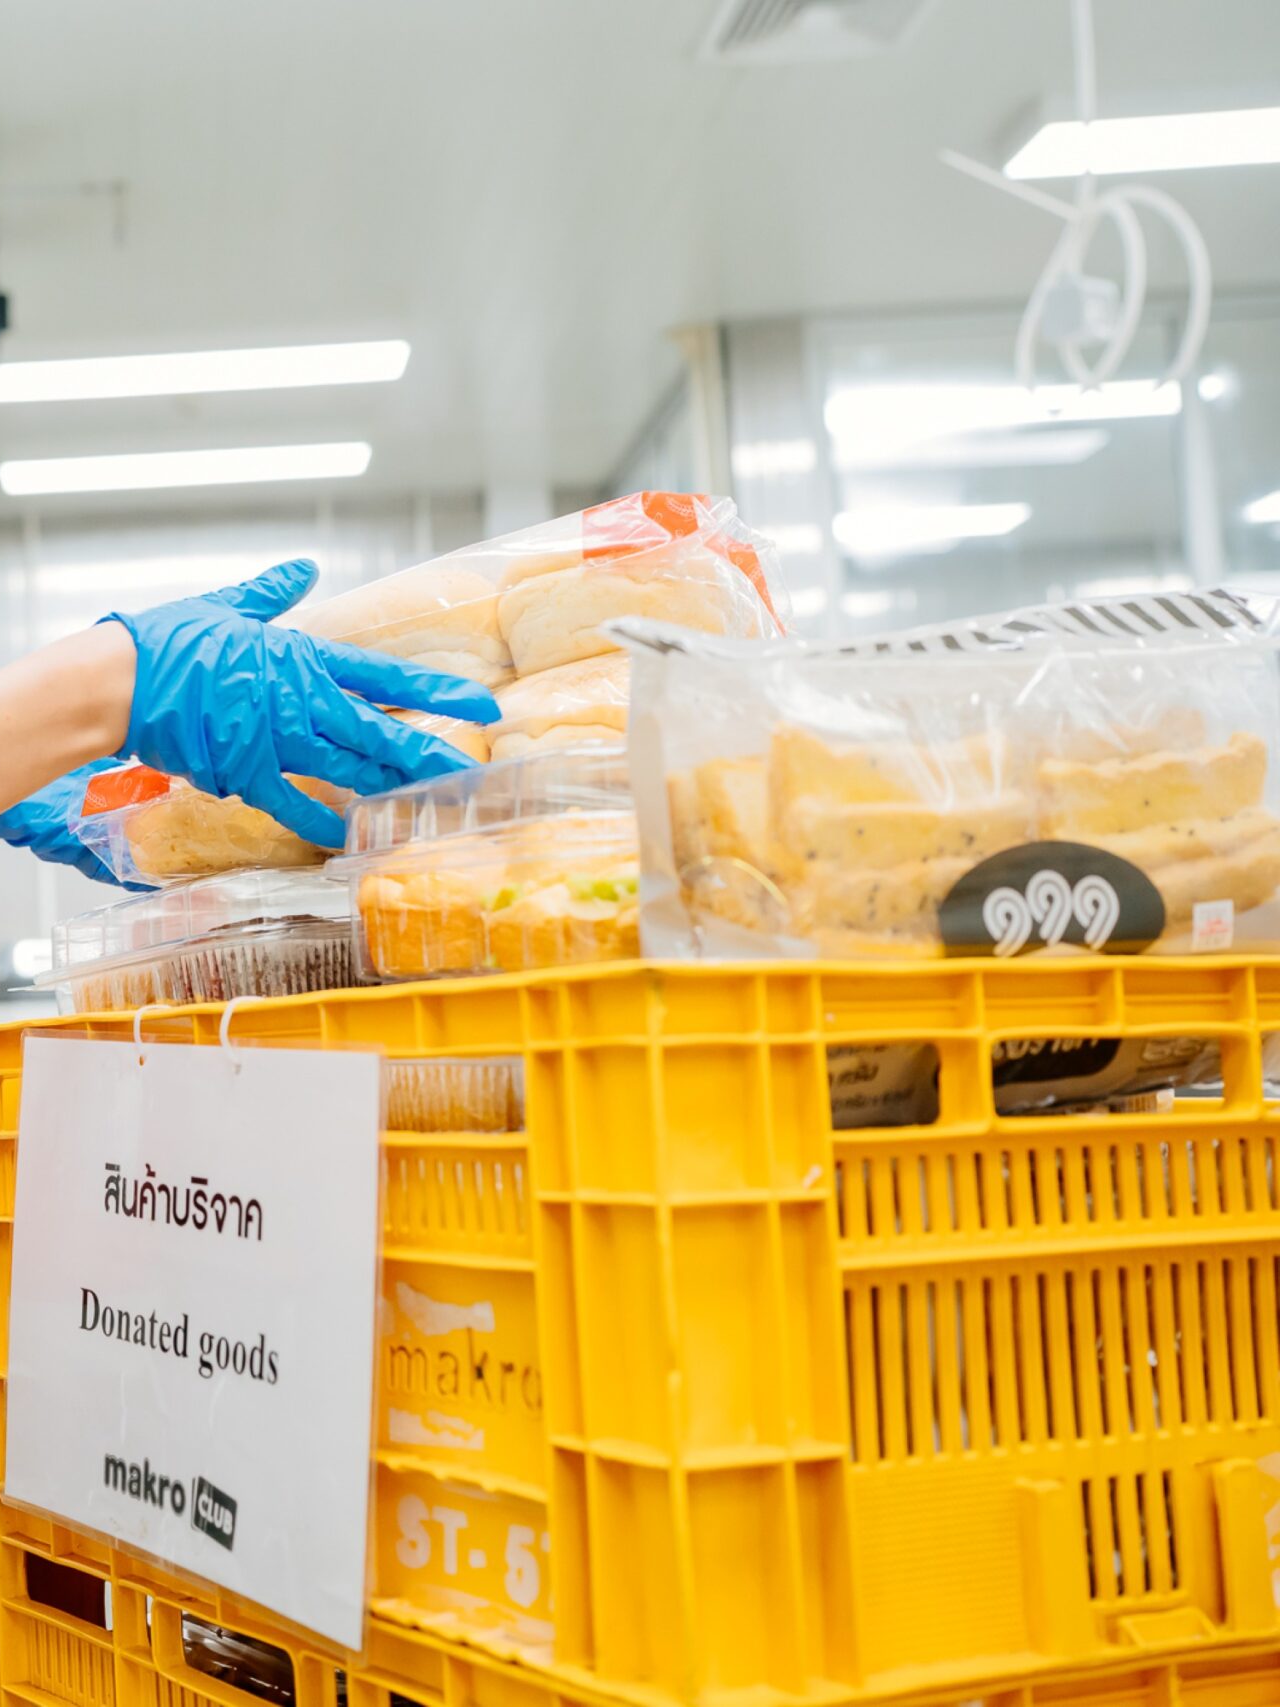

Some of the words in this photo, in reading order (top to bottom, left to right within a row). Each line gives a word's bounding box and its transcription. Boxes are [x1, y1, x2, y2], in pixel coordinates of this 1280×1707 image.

[982, 869, 1120, 958] 999
[104, 1162, 262, 1241] สินค้าบริจาค
[79, 1286, 189, 1358] Donated
[198, 1333, 279, 1385] goods
[104, 1453, 186, 1516] makro
[197, 1492, 234, 1536] CLUB
